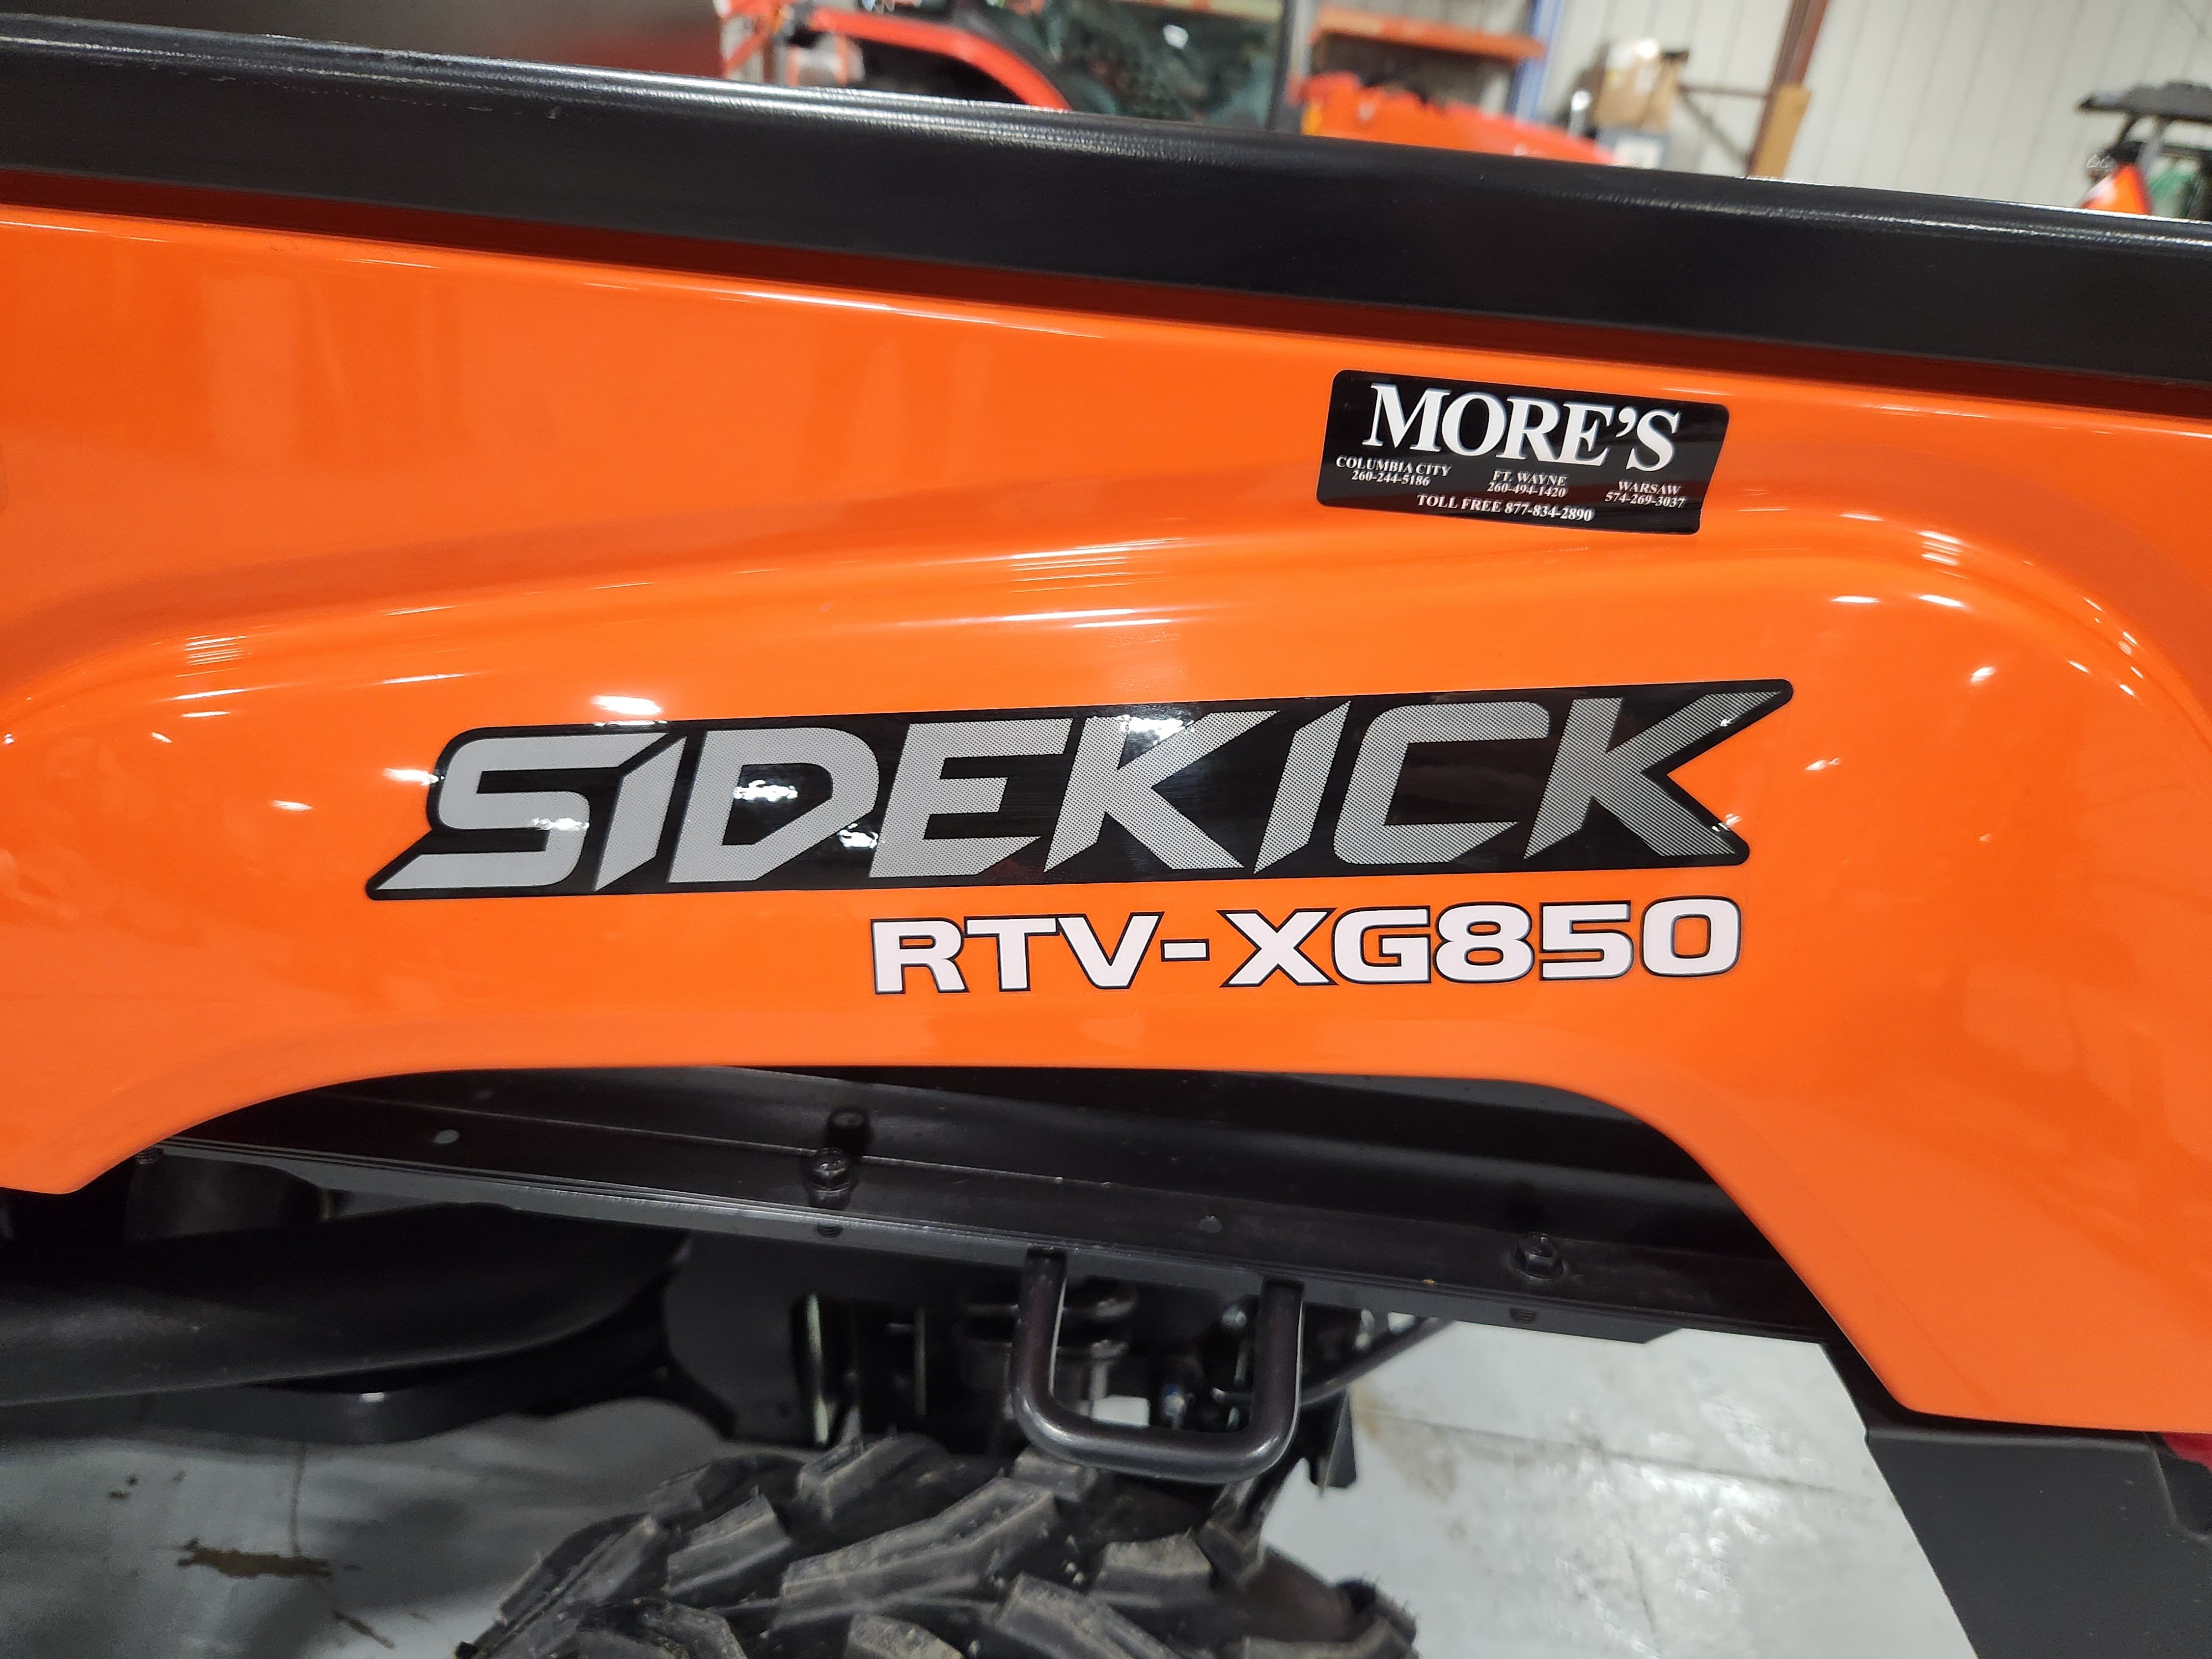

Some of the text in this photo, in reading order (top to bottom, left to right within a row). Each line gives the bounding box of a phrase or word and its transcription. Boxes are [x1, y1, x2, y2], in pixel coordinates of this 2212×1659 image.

[1362, 382, 1681, 472] MORE'S
[1335, 456, 1452, 477] COLUMBIA CITY
[1351, 470, 1430, 487] 260-244-5186
[1493, 469, 1567, 487] FT. WAYNE
[1618, 480, 1681, 495] WARSAW
[1486, 482, 1567, 498] 260-494-1420
[1416, 494, 1593, 522] TOLL FREE 877-834-2890
[1605, 492, 1686, 509] 574-269-3037
[377, 691, 1784, 890] SIDEKICK
[872, 897, 1742, 995] RTV-XG850
